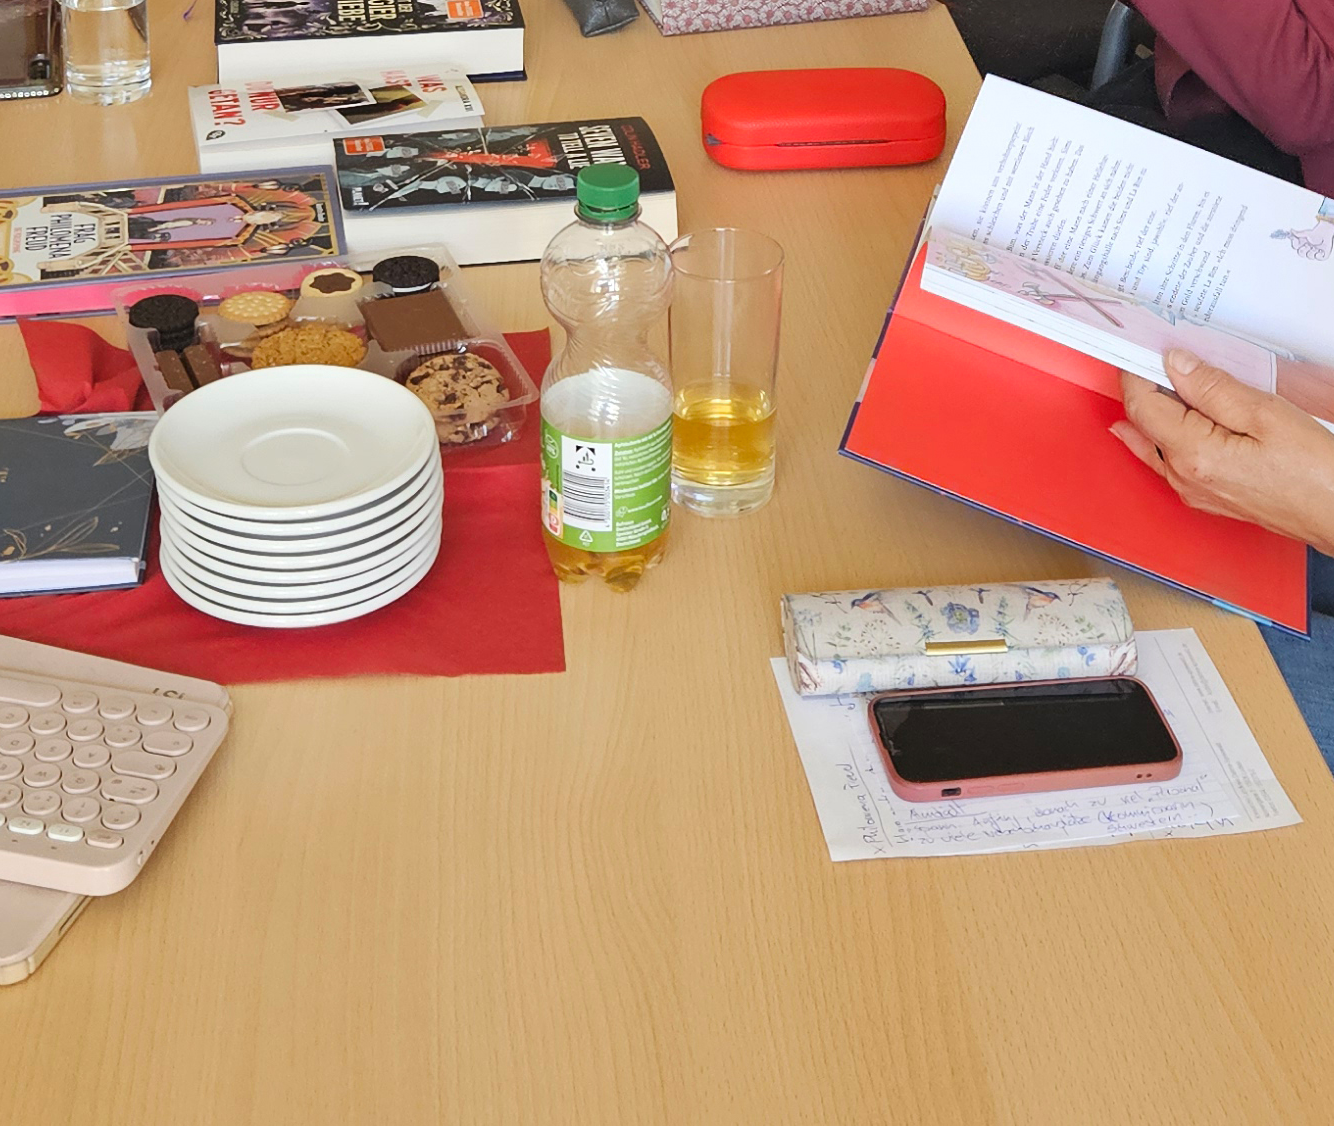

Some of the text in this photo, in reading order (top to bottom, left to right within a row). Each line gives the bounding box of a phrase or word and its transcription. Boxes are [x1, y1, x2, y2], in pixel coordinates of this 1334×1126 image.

[248, 90, 281, 112] NUR
[416, 73, 448, 93] WAS
[207, 88, 246, 126] GETAN?
[557, 132, 580, 140] TO
[560, 138, 584, 154] TELL
[578, 124, 628, 165] SEVEN WA
[629, 140, 652, 171] HADLER
[985, 201, 1003, 236] schleichen
[998, 187, 1009, 201] und
[1013, 221, 1022, 234] was
[1019, 209, 1028, 220] der
[1024, 189, 1036, 208] Mann
[1031, 181, 1039, 189] in
[1035, 169, 1044, 181] der
[1040, 152, 1051, 169] Hand
[1123, 196, 1134, 209] und
[1128, 187, 1137, 196] La
[49, 214, 72, 260] PHILOMENA
[73, 223, 96, 244] FRAG
[1020, 238, 1030, 250] der
[1026, 217, 1038, 238] Truhe
[1034, 202, 1044, 216] eine
[1040, 183, 1052, 201] Feder
[1031, 228, 1047, 257] Versteck
[1043, 211, 1055, 229] auch
[1051, 186, 1068, 212] gesehen
[1061, 177, 1069, 186] zu
[1057, 250, 1066, 263] der
[1063, 235, 1073, 250] eine
[1070, 215, 1081, 234] Mann
[1078, 198, 1088, 214] nach
[1085, 181, 1096, 198] einer
[1072, 249, 1081, 261] ein
[1077, 225, 1092, 249] riesiges
[1088, 199, 1103, 225] Schwert
[1099, 189, 1107, 199] an
[1103, 177, 1112, 190] sich
[1083, 254, 1094, 270] Zum
[1089, 233, 1101, 253] Glück
[1098, 211, 1112, 233] kamen
[1108, 200, 1117, 211] die
[1113, 179, 1126, 200] beiden
[1109, 225, 1121, 241] nach
[1134, 235, 1145, 248] rief
[1140, 224, 1150, 235] der
[25, 226, 48, 251] FREUD
[1131, 277, 1141, 290] und
[1163, 203, 1174, 215] rief
[1169, 192, 1179, 203] der
[1158, 276, 1170, 290] ihre
[1165, 250, 1182, 276] Schritte
[1175, 242, 1185, 250] in
[1180, 230, 1191, 243] den
[1192, 288, 1208, 312] seufzte
[1203, 278, 1211, 287] La
[1229, 204, 1248, 232] dringend
[1168, 280, 1182, 303] endete
[1177, 268, 1187, 279] der
[1182, 245, 1198, 268] Zauber
[1193, 232, 1204, 245] und
[1200, 221, 1209, 232] die
[1180, 249, 1211, 306] Gold verschwand.
